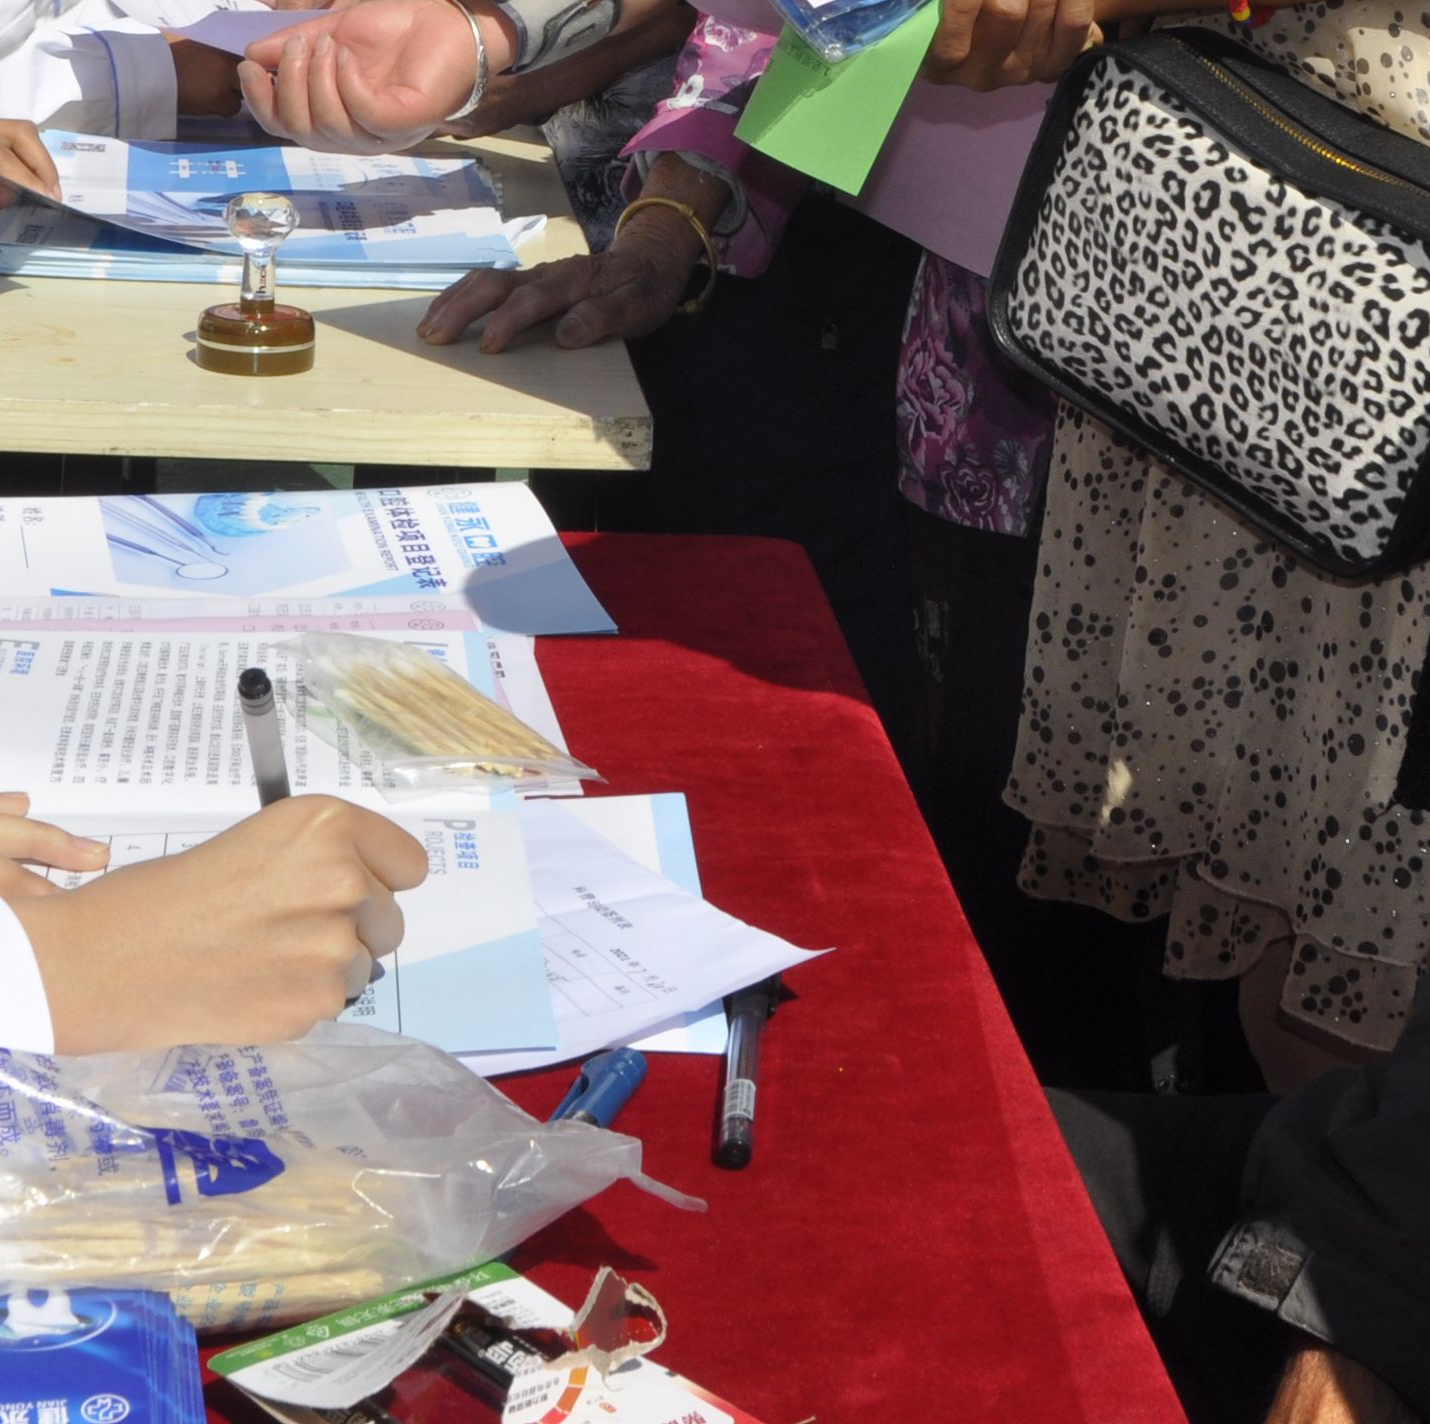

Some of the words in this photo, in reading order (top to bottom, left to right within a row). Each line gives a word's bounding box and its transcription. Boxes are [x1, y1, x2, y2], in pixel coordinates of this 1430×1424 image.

[376, 488, 447, 590] 口腔体检项目登记表
